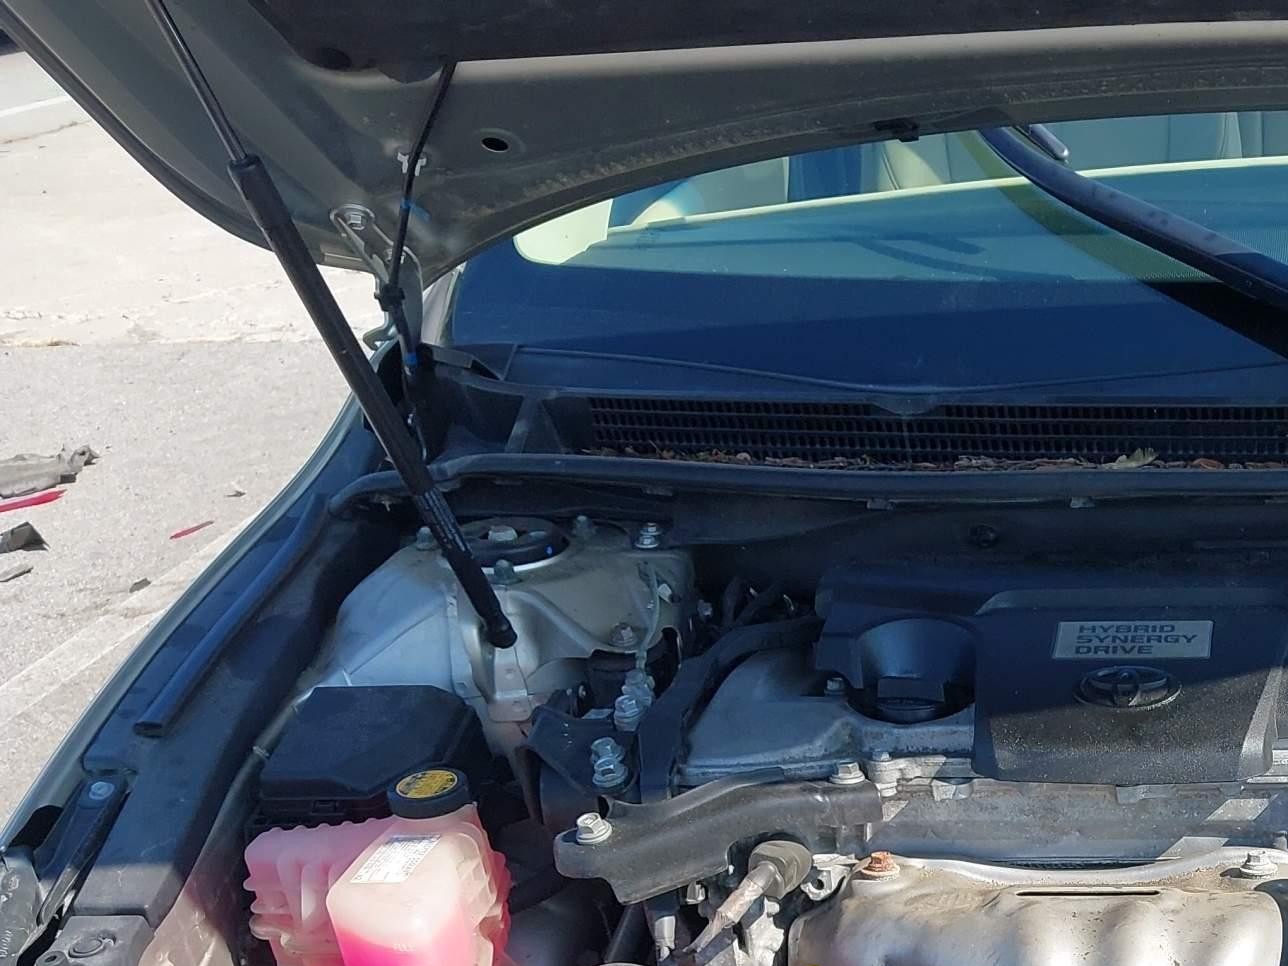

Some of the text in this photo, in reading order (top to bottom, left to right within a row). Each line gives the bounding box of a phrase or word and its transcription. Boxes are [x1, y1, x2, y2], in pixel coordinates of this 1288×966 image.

[1078, 624, 1176, 634] HYBRID
[1076, 634, 1198, 644] SYNERGY
[1074, 645, 1154, 655] DRIVE
